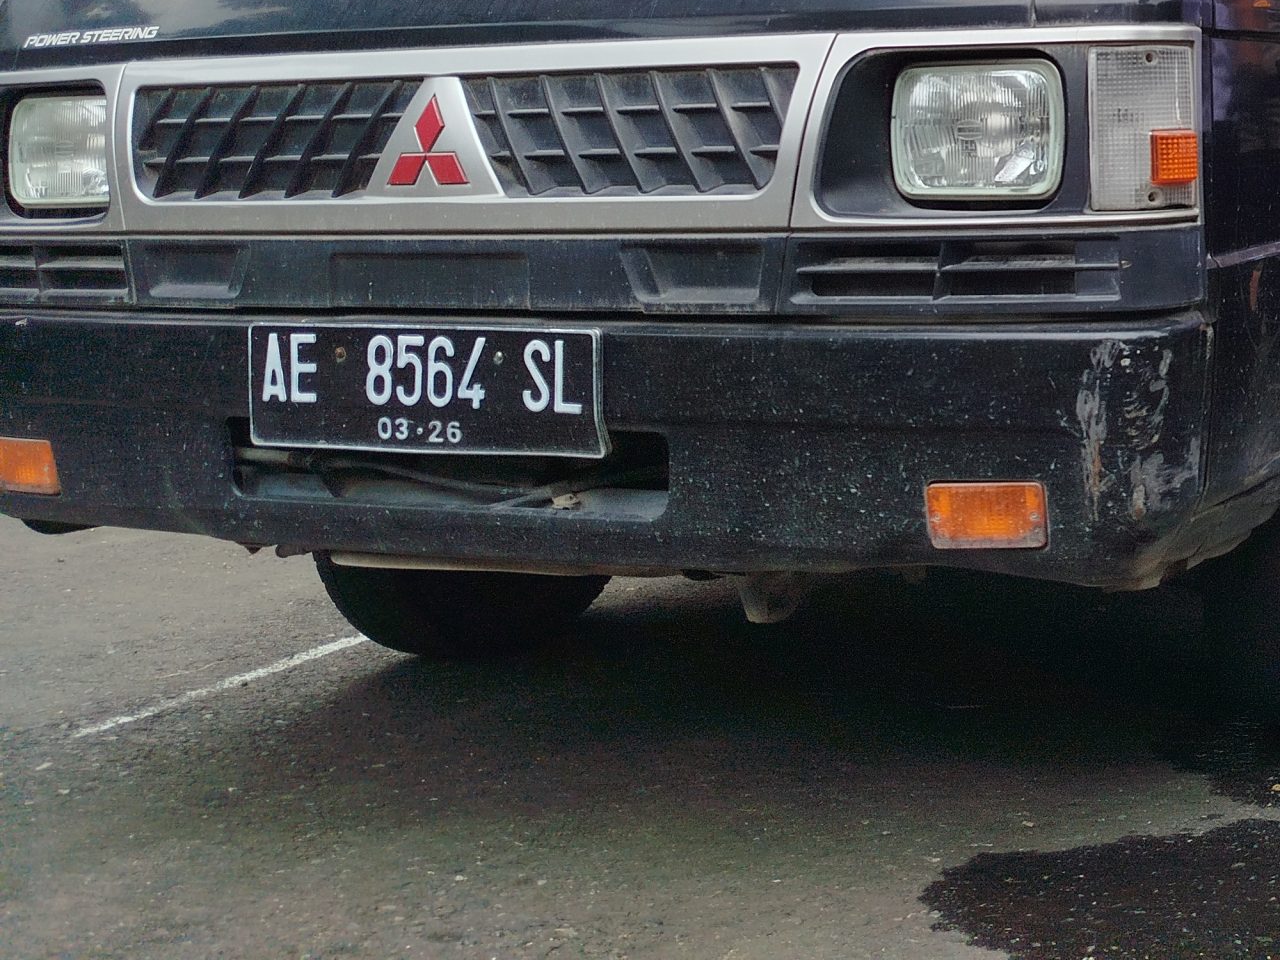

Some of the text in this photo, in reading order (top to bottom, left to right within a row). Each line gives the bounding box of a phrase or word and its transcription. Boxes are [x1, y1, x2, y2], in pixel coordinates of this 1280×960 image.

[23, 26, 160, 49] POWER STEERING
[262, 333, 583, 414] AE 8564 SL
